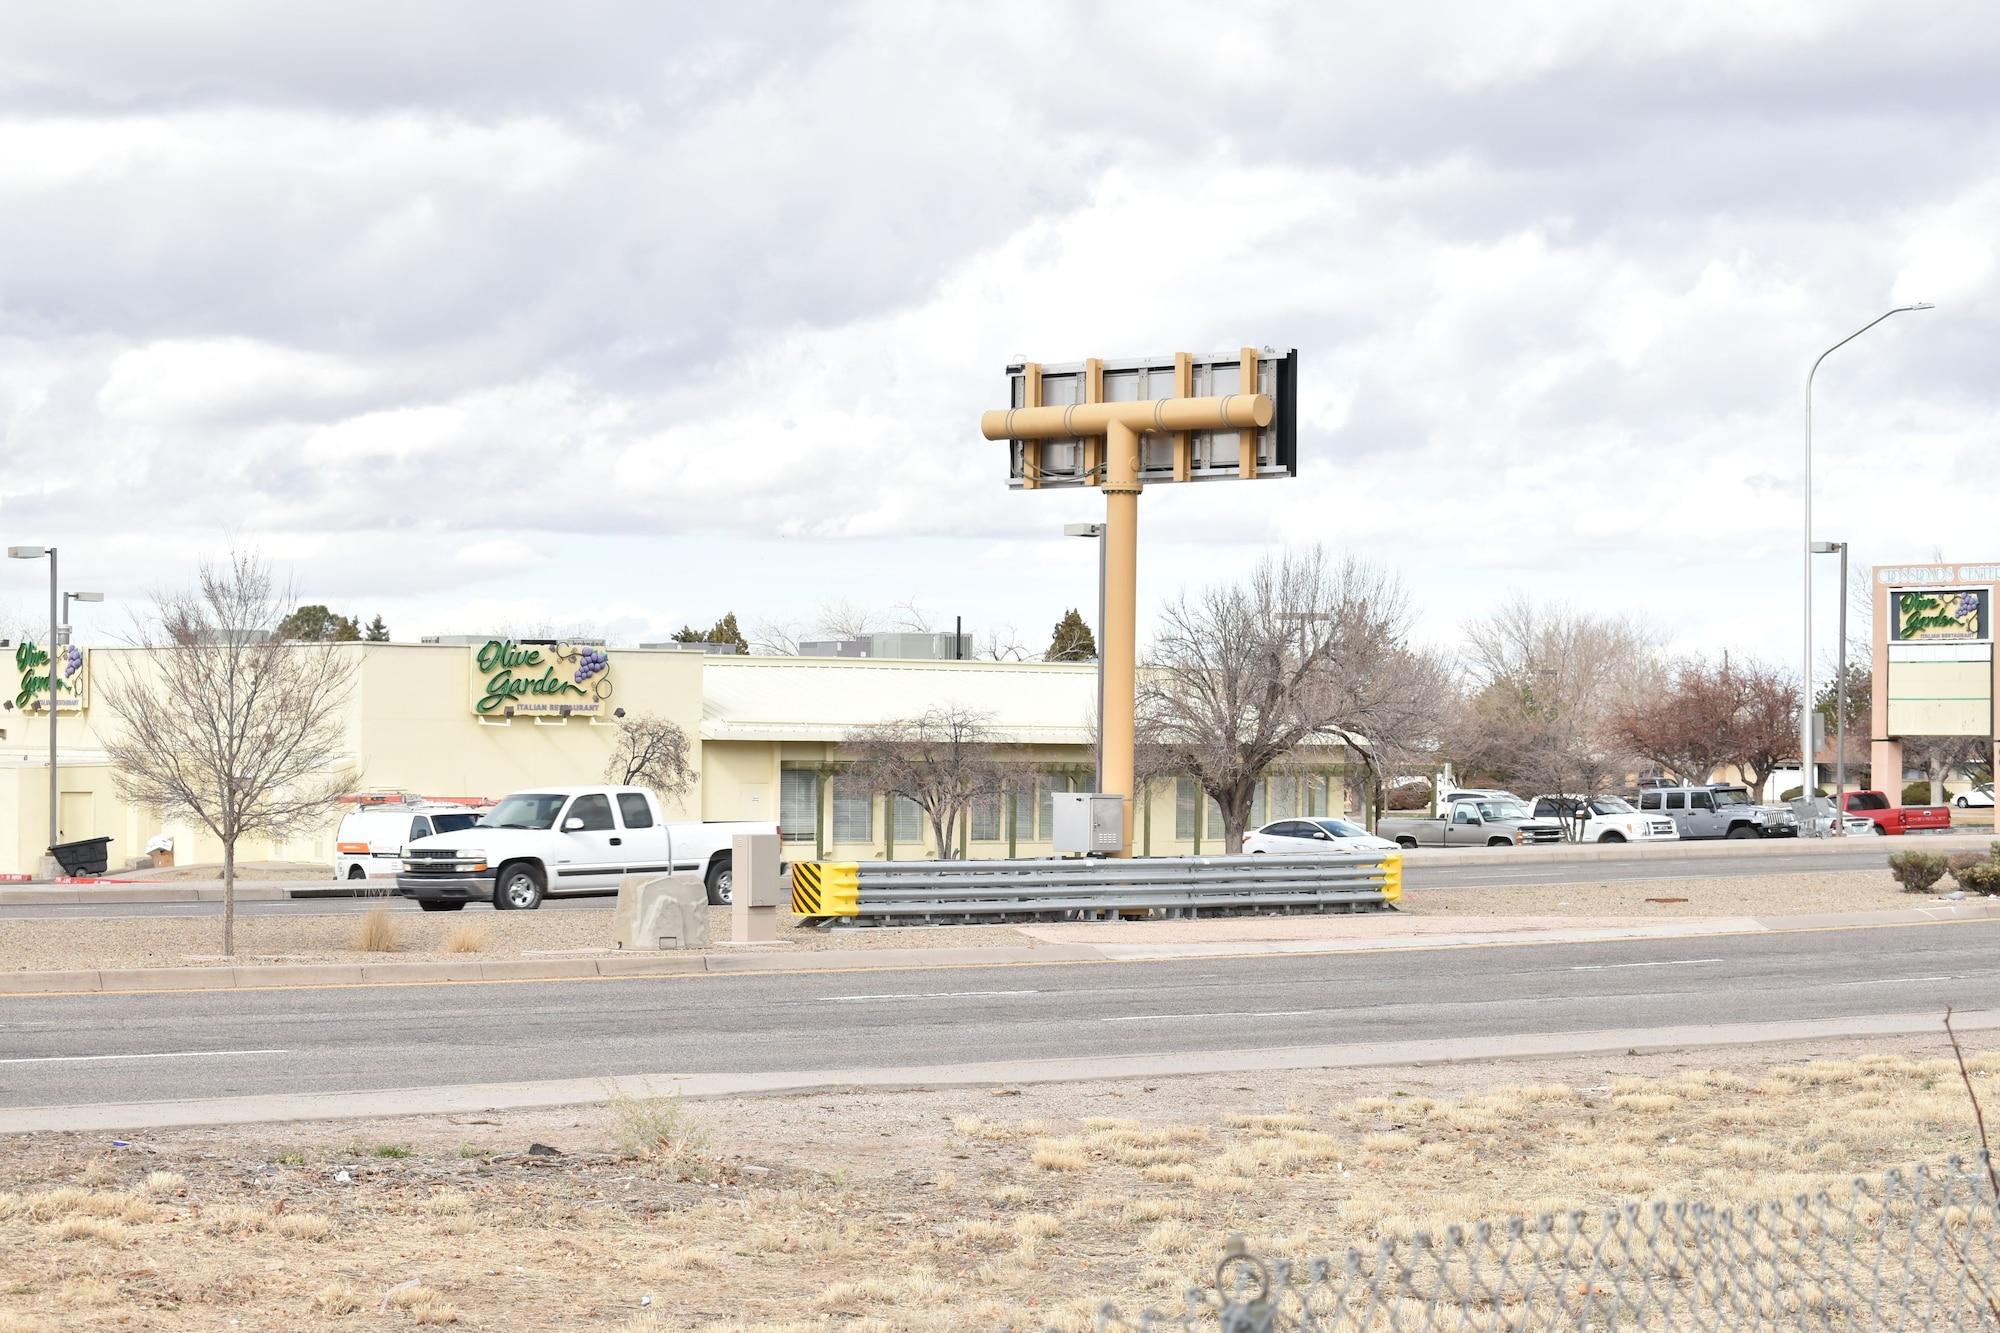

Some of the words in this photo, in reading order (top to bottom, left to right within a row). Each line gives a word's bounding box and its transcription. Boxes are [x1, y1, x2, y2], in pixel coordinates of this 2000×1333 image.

[1900, 592, 1940, 614] Olive
[1900, 607, 1965, 639] Garden
[477, 639, 545, 673] Olive
[476, 666, 587, 713] Garden
